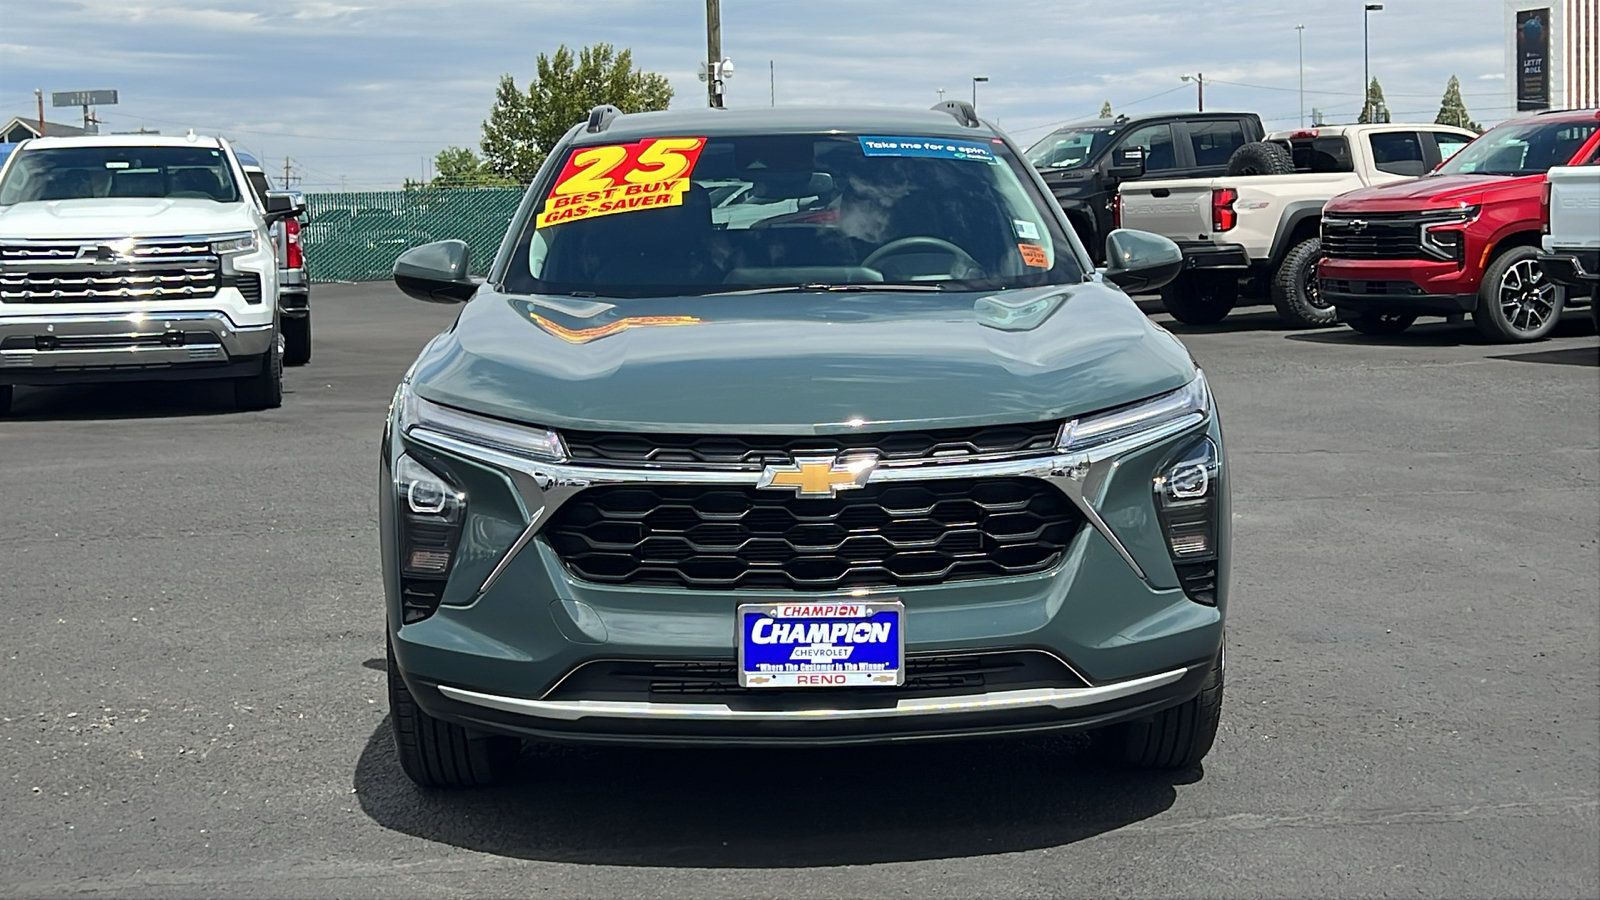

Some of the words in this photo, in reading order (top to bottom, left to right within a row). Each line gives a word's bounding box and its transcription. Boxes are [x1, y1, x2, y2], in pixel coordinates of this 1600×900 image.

[1525, 66, 1541, 74] ROLL
[865, 141, 897, 149] Take
[958, 146, 990, 155] spin.
[555, 138, 702, 195] 25
[553, 188, 618, 209] BEST
[625, 180, 680, 196] BUY
[544, 193, 673, 224] GAS-SAVER
[783, 606, 859, 617] CHAMPION
[751, 618, 892, 645] CHAMPION
[794, 648, 849, 657] CHEVROLET
[785, 663, 799, 671] The
[800, 662, 835, 672] Customer
[844, 662, 857, 671] The
[797, 675, 847, 685] RENO
